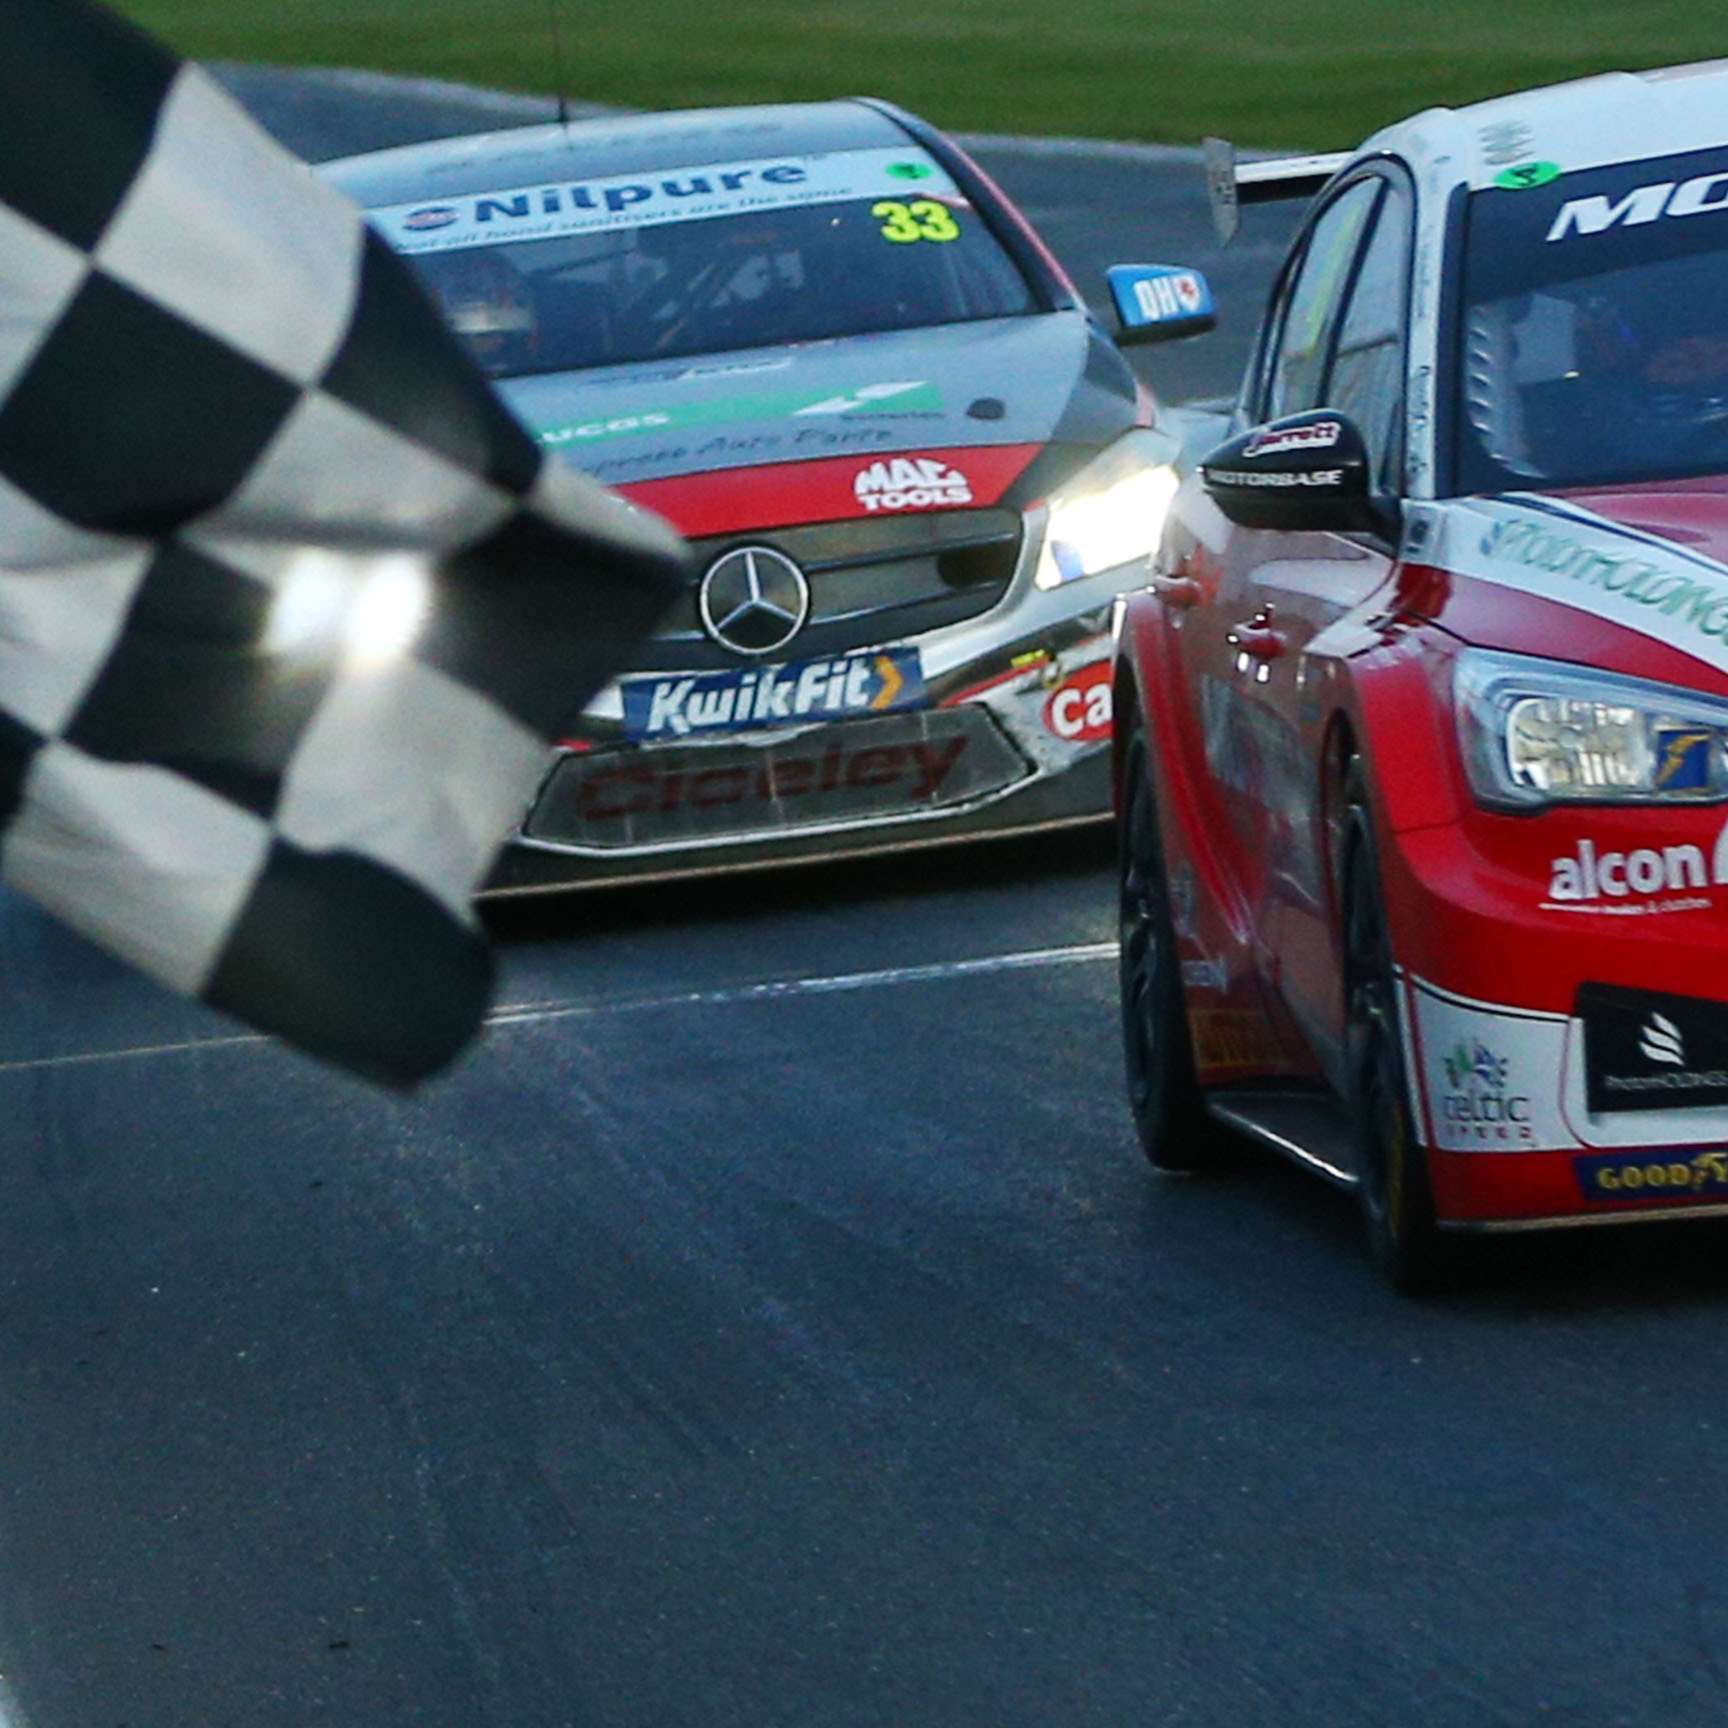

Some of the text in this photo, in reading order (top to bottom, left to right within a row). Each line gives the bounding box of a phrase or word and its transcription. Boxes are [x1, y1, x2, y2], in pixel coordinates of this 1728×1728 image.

[476, 165, 807, 222] Nilpure
[872, 200, 961, 244] 33
[854, 458, 969, 496] MAC
[858, 486, 973, 511] TOOLS
[1548, 838, 1709, 901] alcon
